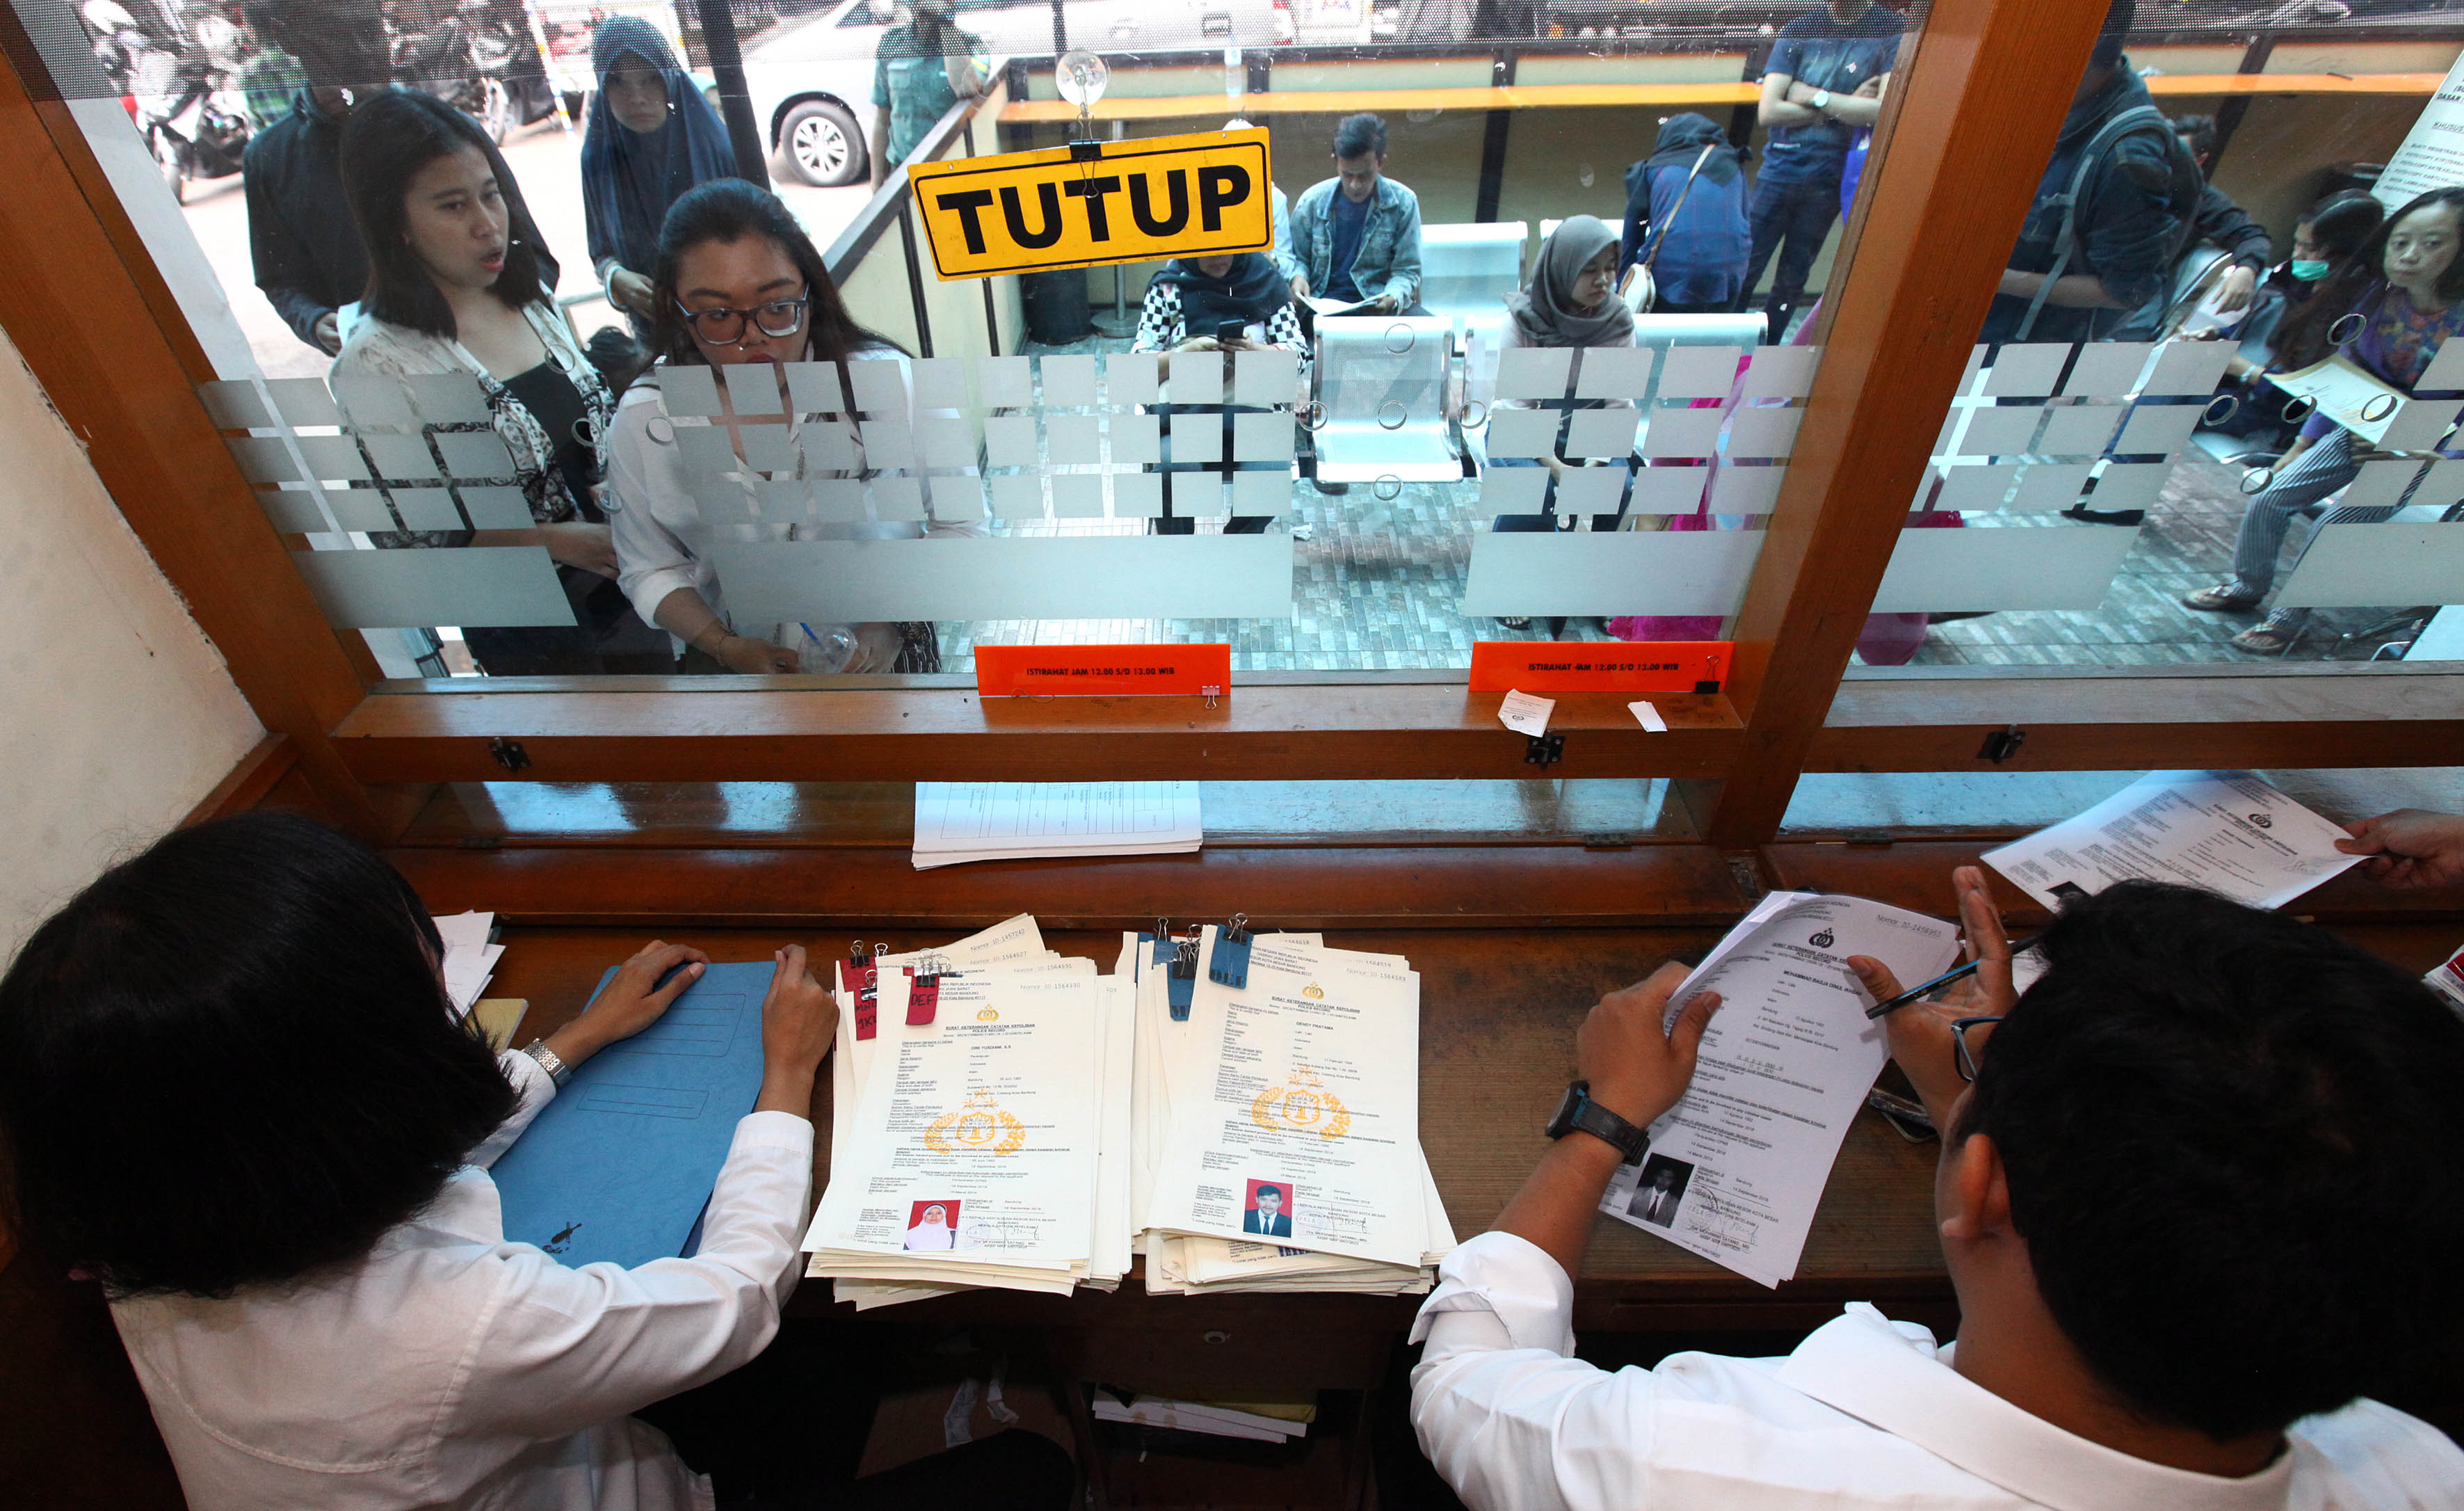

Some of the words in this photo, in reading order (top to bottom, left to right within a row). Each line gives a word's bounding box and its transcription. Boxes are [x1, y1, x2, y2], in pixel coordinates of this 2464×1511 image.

[936, 164, 1250, 255] TUTUP
[1876, 914, 1899, 927] Nomor
[970, 941, 990, 952] Nomor
[911, 993, 935, 1007] DEF
[1287, 998, 1314, 1007] KETERANGAN
